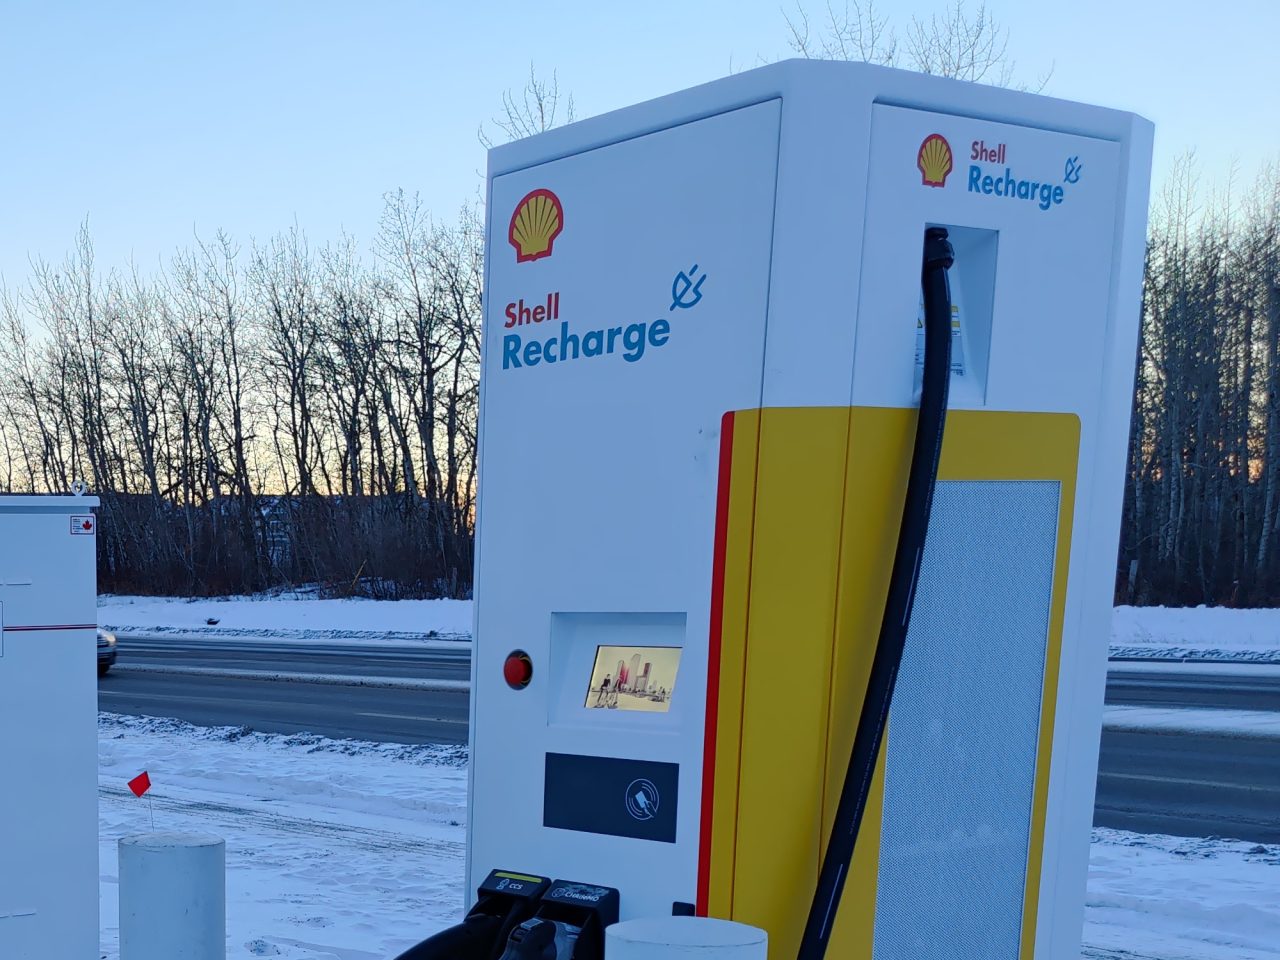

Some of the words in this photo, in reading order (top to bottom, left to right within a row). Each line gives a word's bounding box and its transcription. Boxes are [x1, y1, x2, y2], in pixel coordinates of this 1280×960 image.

[970, 140, 1007, 164] Shell
[968, 165, 1064, 211] Recharge
[504, 292, 560, 328] Shell
[502, 318, 670, 370] Recharge
